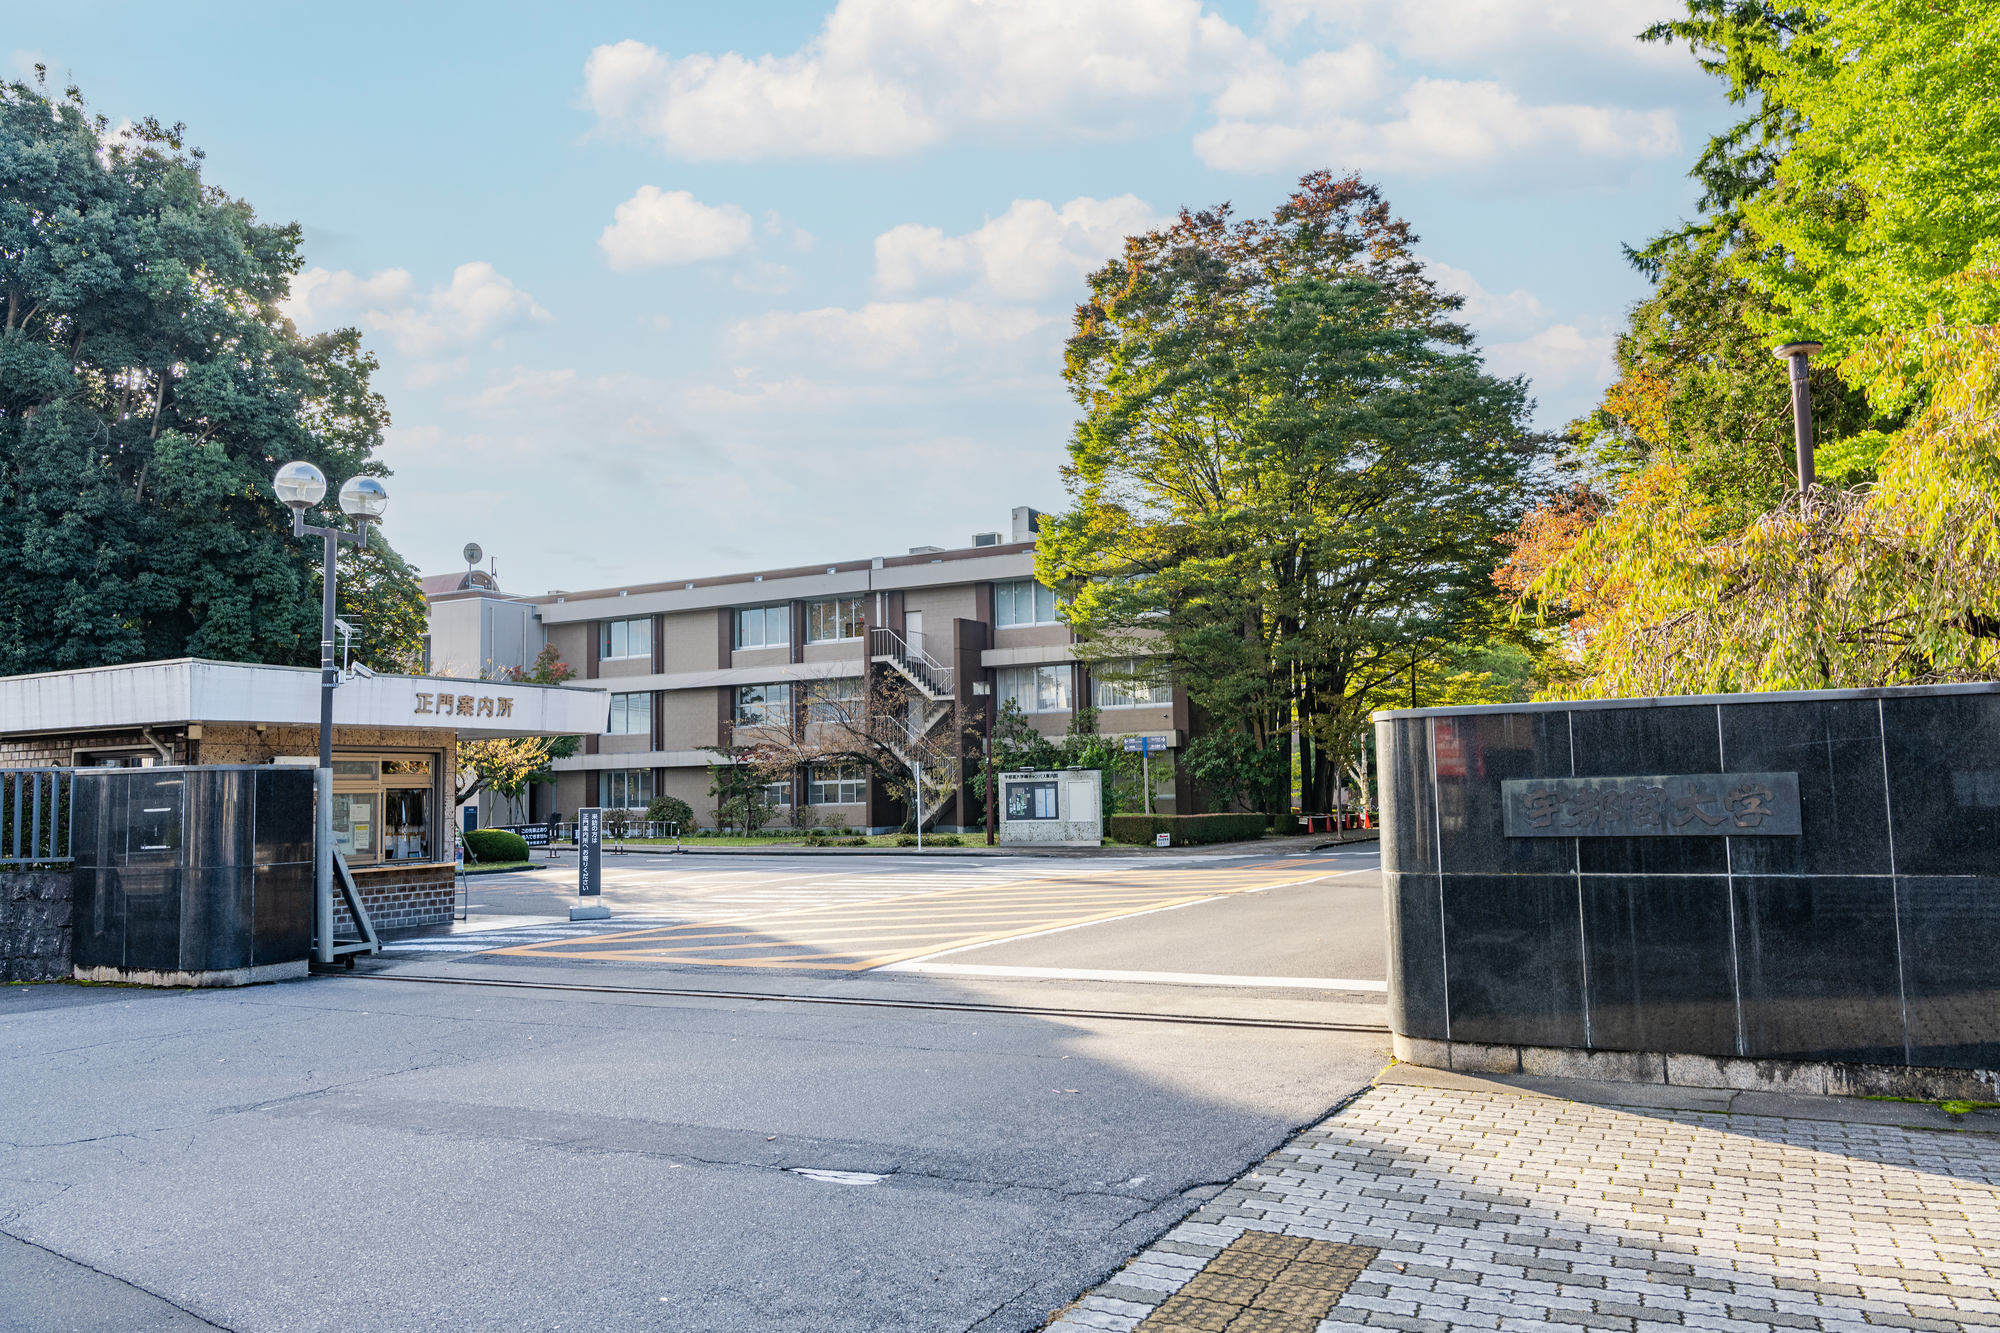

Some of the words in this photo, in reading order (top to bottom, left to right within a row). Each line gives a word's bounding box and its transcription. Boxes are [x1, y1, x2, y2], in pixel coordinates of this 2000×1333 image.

[414, 693, 514, 718] 正門案内所
[1522, 782, 1774, 829] 宇都宮大学
